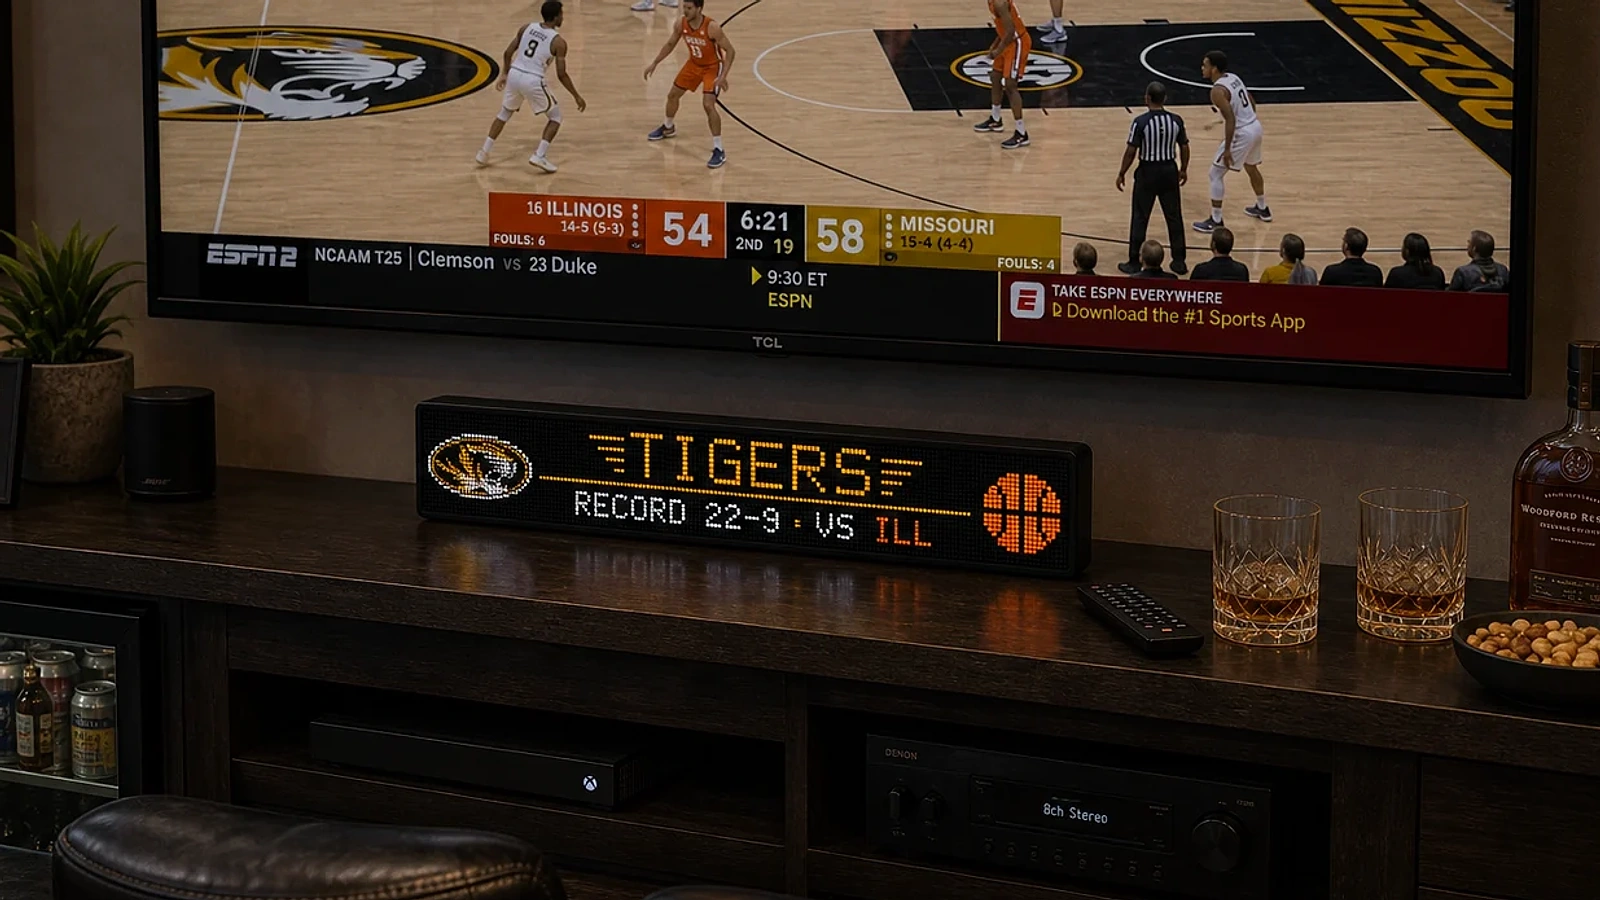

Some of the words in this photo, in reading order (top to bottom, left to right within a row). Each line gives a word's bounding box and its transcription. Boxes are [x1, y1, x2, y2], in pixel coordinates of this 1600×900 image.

[528, 201, 542, 214] 16
[547, 201, 623, 220] ILLINOIS
[561, 221, 588, 232] 14-5
[594, 222, 624, 236] (5-3)
[664, 212, 712, 247] 54
[741, 210, 787, 231] 6:21
[901, 216, 995, 236] MISSOURI
[494, 234, 533, 245] FOULS:
[538, 236, 545, 245] 6
[818, 218, 863, 253] 58
[901, 236, 932, 248] 15-4
[938, 237, 972, 252] (4-4)
[736, 237, 762, 250] 2ND
[774, 239, 793, 254] 19
[316, 248, 370, 263] NCAAM
[375, 251, 401, 264] T25
[418, 250, 493, 269] Clemson
[530, 257, 546, 271] 23
[552, 257, 596, 274] Duke
[998, 258, 1042, 269] FOULS:
[1047, 260, 1054, 269] 4
[768, 270, 802, 285] 9:30
[809, 272, 827, 286] ET
[769, 293, 811, 308] ESPN
[1052, 285, 1086, 297] TAKE
[1091, 287, 1125, 299] ESPN
[1131, 289, 1222, 304] EVERYWHERE
[1067, 302, 1148, 322] Download
[1153, 307, 1178, 323] the
[1185, 309, 1204, 324] #1
[1210, 310, 1265, 328] Sports
[1271, 313, 1305, 332] App
[753, 337, 782, 348] TCL
[630, 432, 870, 496] TIGERS
[574, 490, 686, 525] RECORD
[706, 503, 779, 533] 22-9
[816, 512, 853, 539] VS
[877, 517, 931, 546] ILL
[1521, 504, 1577, 519] WOODFORD
[886, 749, 917, 759] DENON
[1044, 803, 1063, 816] 8ch
[1070, 807, 1107, 823] Stereo
